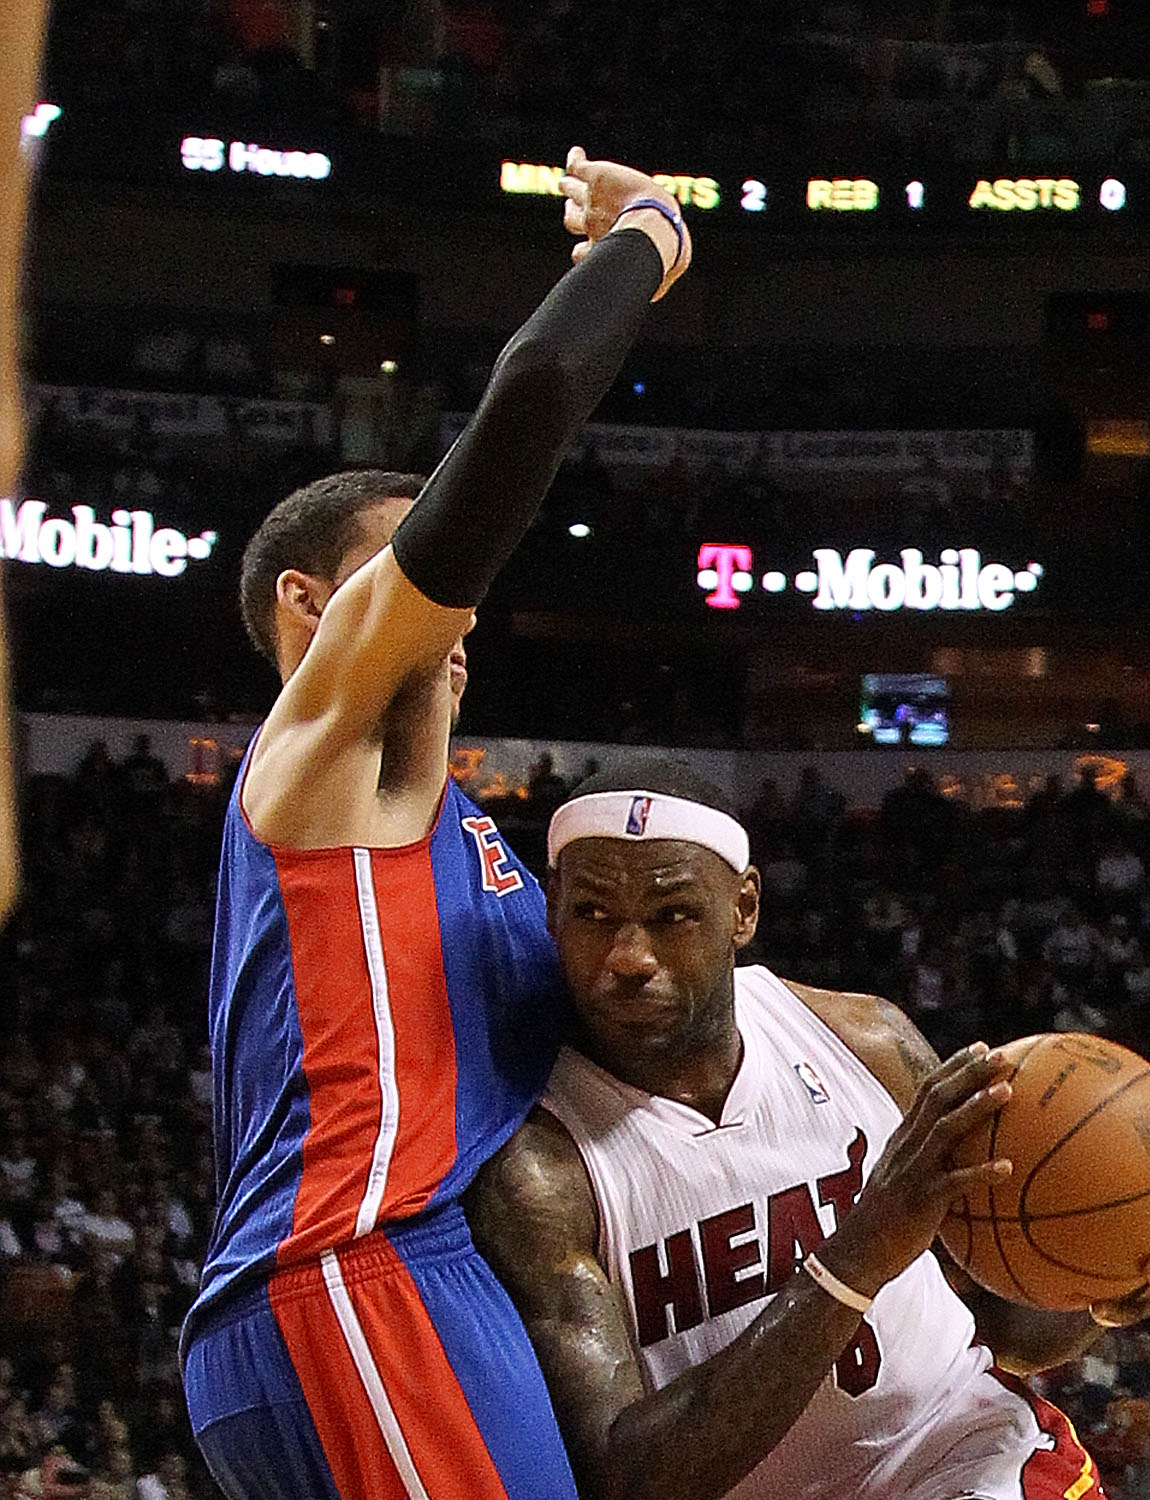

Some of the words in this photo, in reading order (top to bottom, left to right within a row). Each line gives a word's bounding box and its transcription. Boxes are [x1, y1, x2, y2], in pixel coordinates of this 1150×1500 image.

[740, 179, 767, 212] 2
[806, 178, 880, 211] REB
[905, 180, 924, 209] 1
[968, 178, 1081, 211] ASSTS
[1100, 178, 1126, 211] 0
[628, 1126, 868, 1348] HEAT
